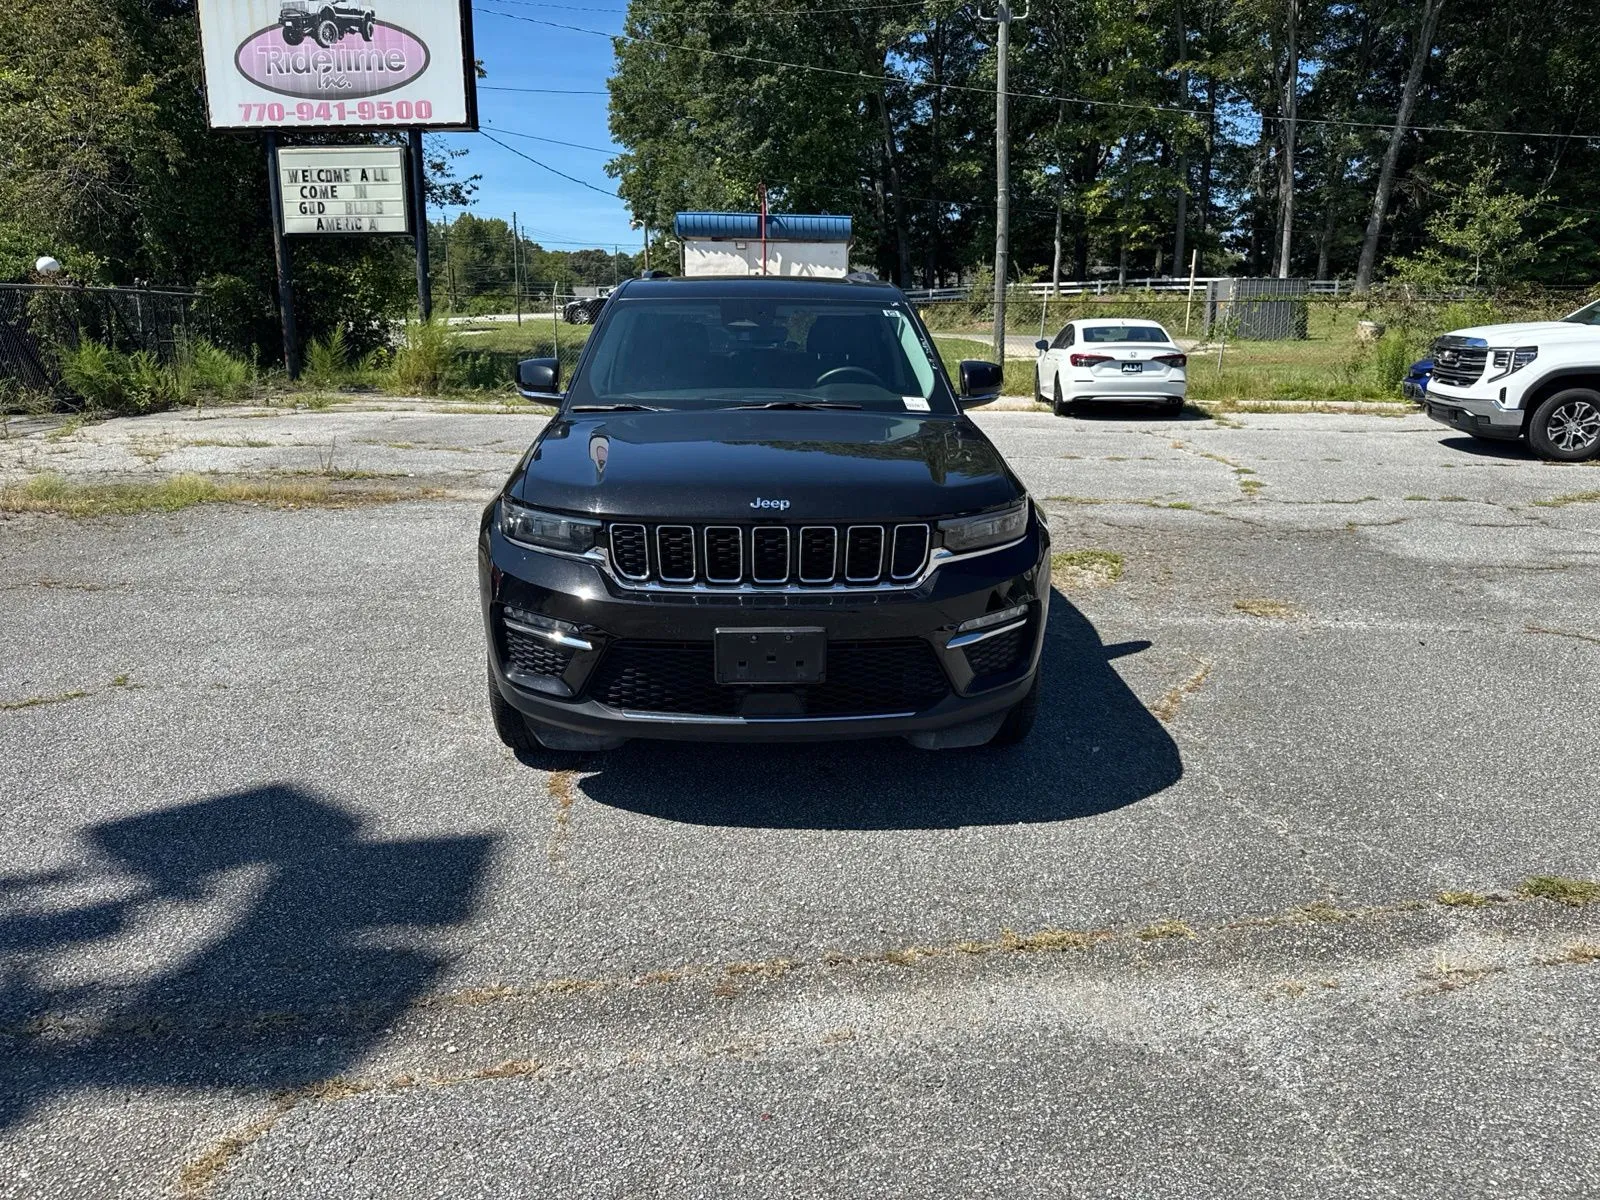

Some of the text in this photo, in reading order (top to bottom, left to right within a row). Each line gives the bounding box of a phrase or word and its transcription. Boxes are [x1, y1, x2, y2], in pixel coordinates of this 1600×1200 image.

[316, 66, 352, 89] Inc.
[238, 100, 433, 122] 770-941-9500
[288, 168, 351, 183] WELCOME
[300, 185, 338, 199] COME
[299, 201, 325, 215] GOD
[1122, 363, 1142, 371] ALM
[750, 497, 790, 511] Jeep
